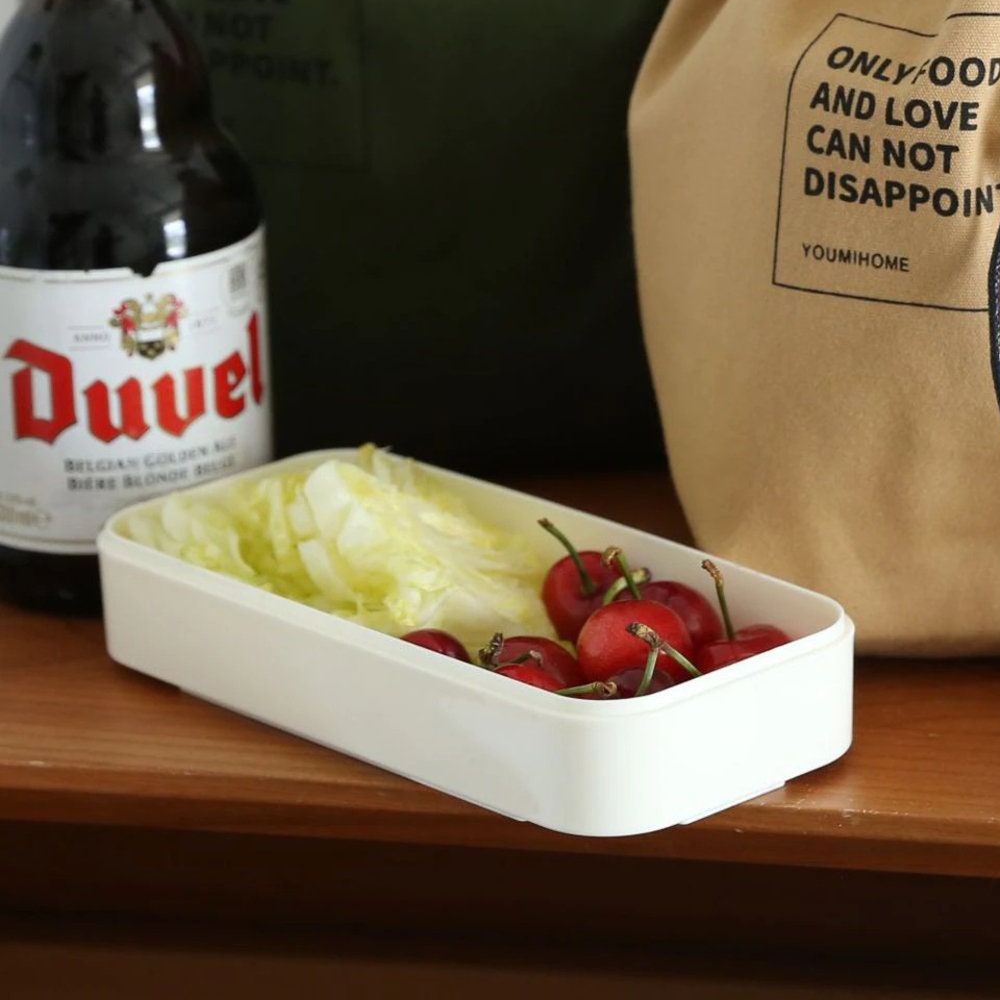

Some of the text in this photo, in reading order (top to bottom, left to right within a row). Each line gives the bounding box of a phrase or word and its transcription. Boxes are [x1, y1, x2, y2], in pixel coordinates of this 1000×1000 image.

[827, 45, 914, 85] ONLY
[810, 82, 979, 131] AND LOVE
[806, 125, 960, 174] CAN NOT
[801, 242, 911, 272] YOUMIHOME
[3, 310, 265, 445] Duvel
